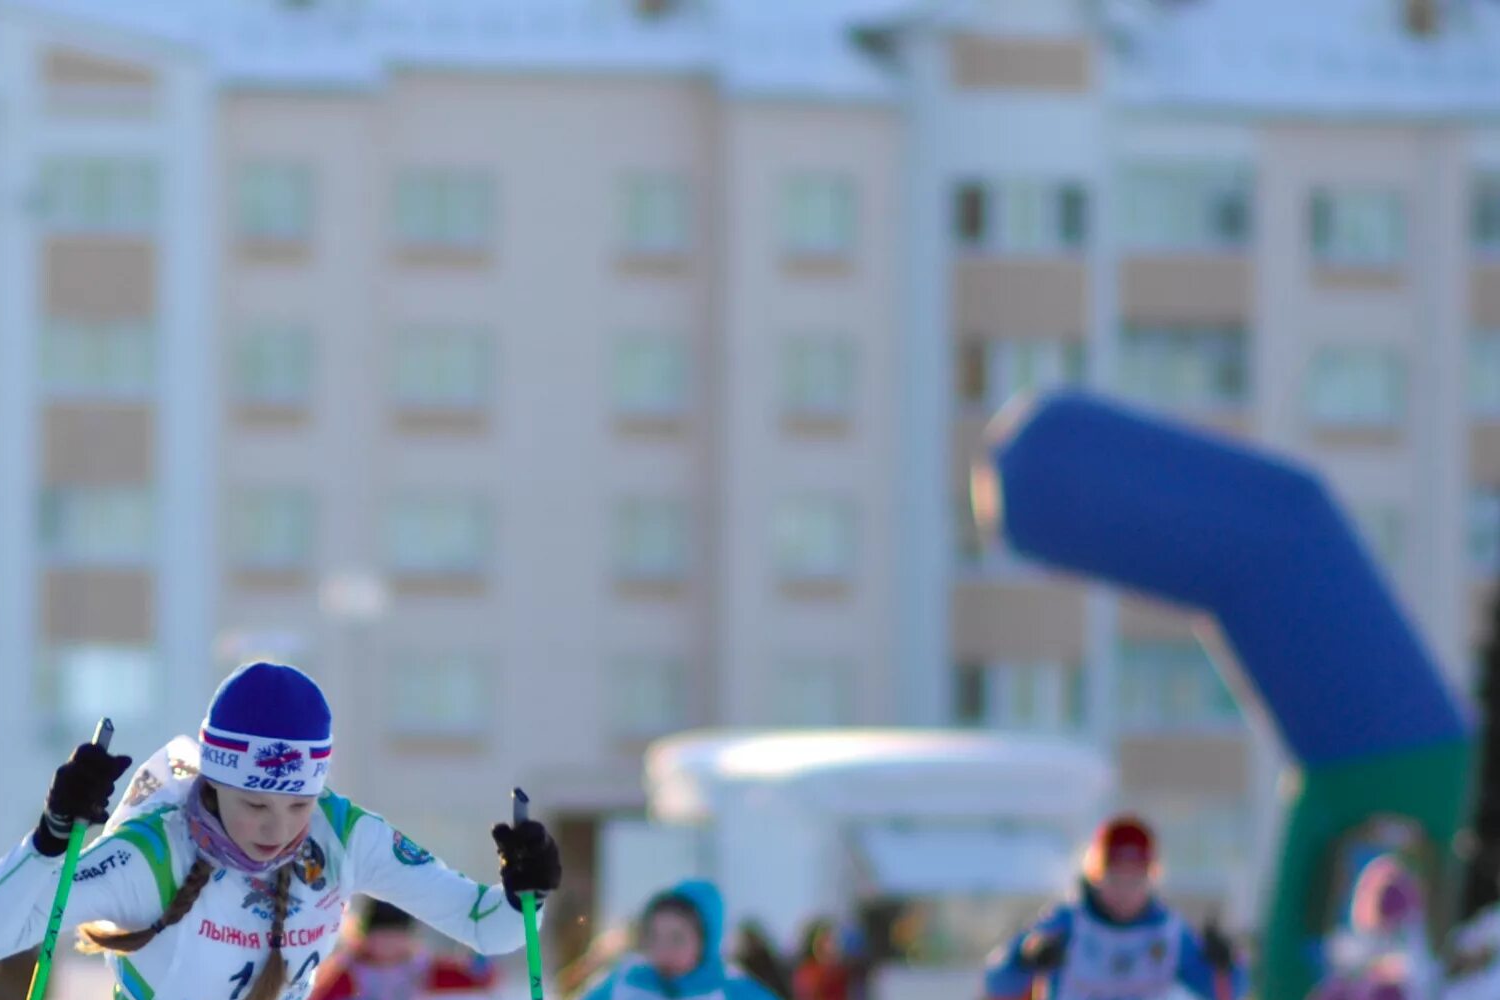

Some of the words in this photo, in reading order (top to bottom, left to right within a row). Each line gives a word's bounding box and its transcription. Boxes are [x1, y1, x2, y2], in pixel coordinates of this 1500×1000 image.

[243, 775, 305, 793] 2012
[73, 855, 116, 882] CRAFT
[199, 919, 261, 949] ЛЫЖНЯ
